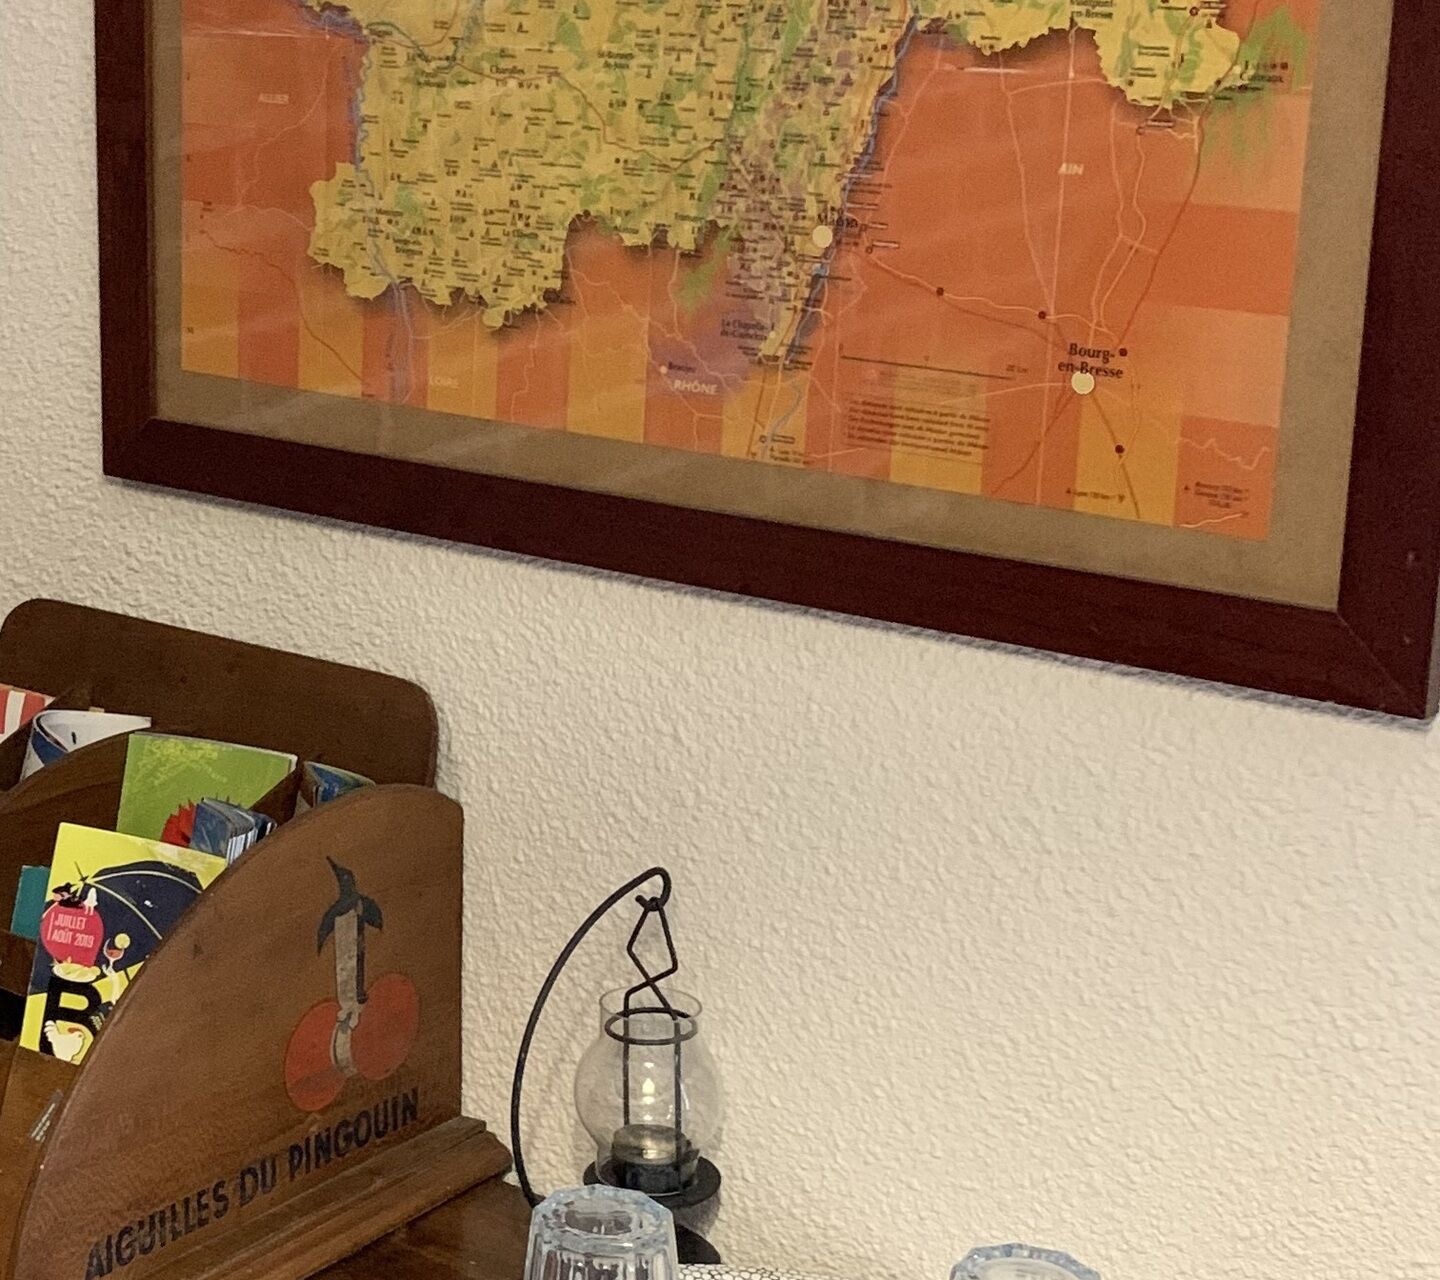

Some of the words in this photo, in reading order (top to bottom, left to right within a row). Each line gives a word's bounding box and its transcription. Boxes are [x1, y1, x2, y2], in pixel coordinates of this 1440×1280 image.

[1068, 342, 1116, 365] Bourg-
[1057, 360, 1124, 380] en-Bresse
[54, 913, 88, 930] JUILLET
[52, 929, 72, 943] AOÛT
[75, 932, 94, 948] 2019
[238, 1153, 279, 1209] DU
[288, 1087, 420, 1182] PINGOUIN
